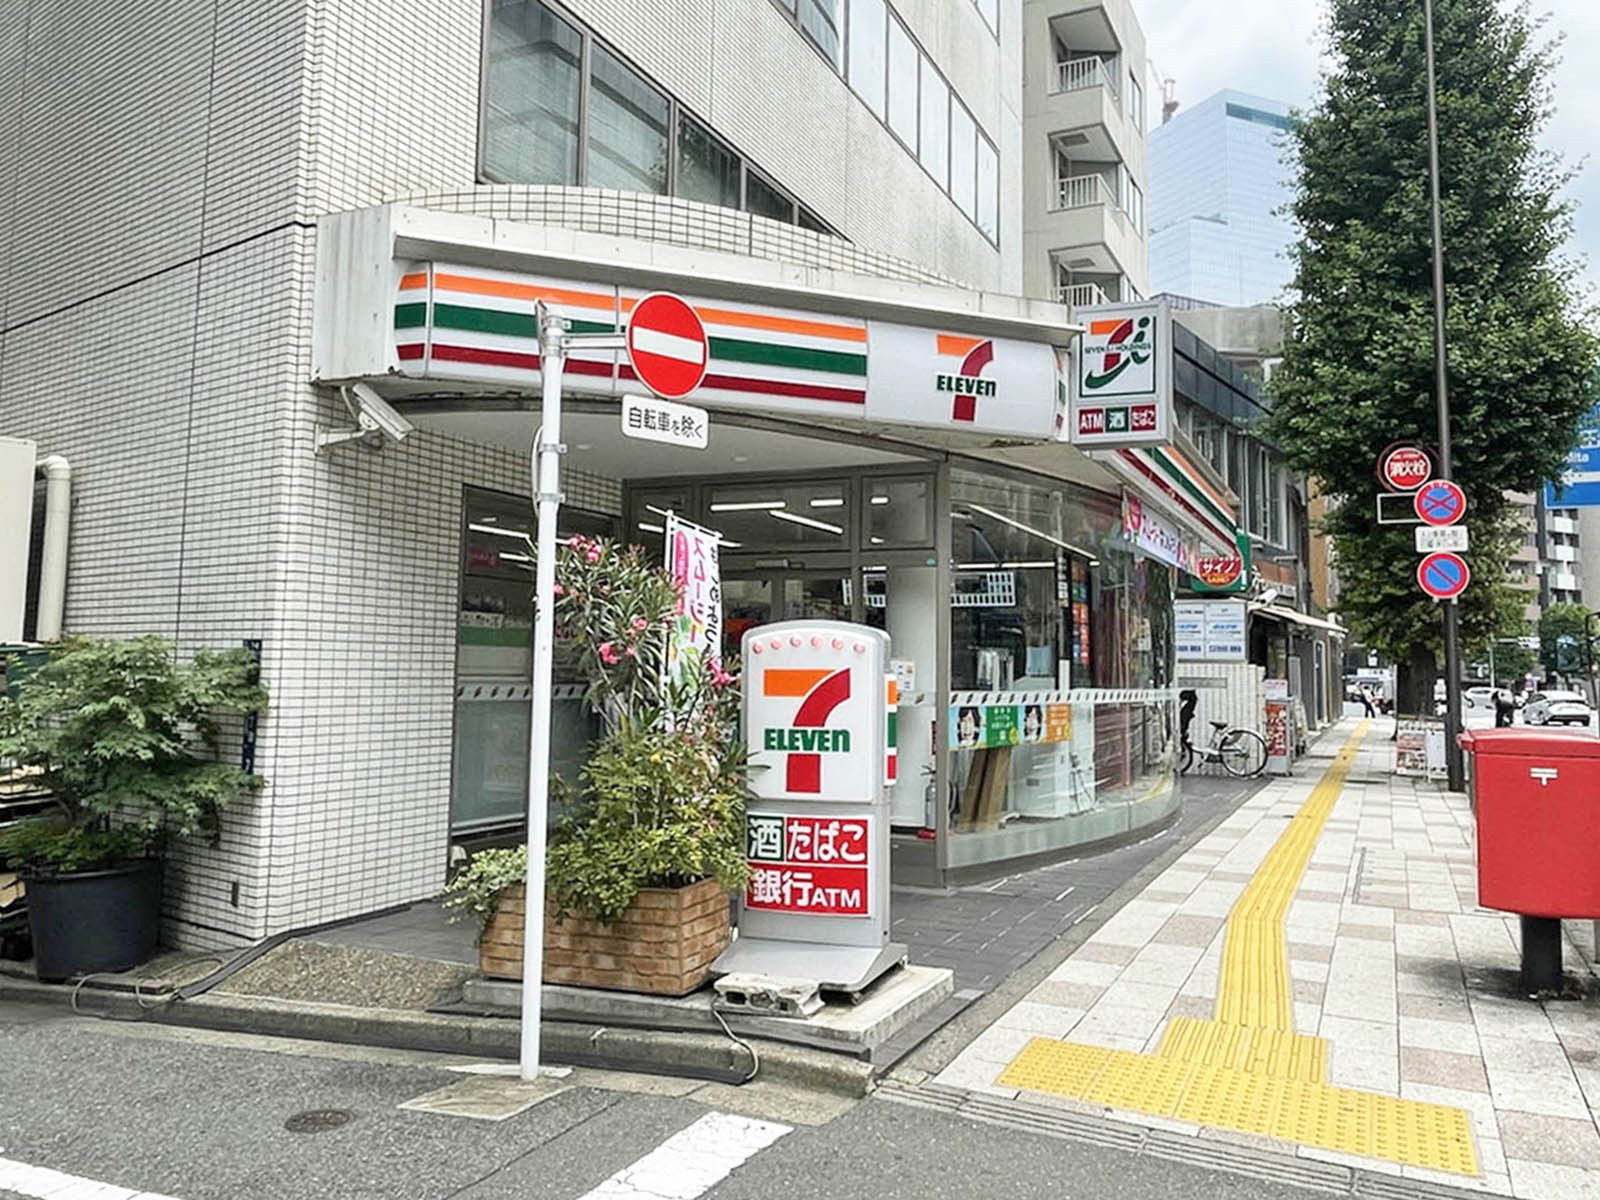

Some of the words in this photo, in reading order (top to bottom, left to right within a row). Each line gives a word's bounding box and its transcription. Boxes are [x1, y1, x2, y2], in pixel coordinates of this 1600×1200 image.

[628, 406, 703, 439] 自転車を除く
[1080, 413, 1103, 430] ATM
[749, 818, 783, 858] 酒
[788, 820, 866, 862] たばこ
